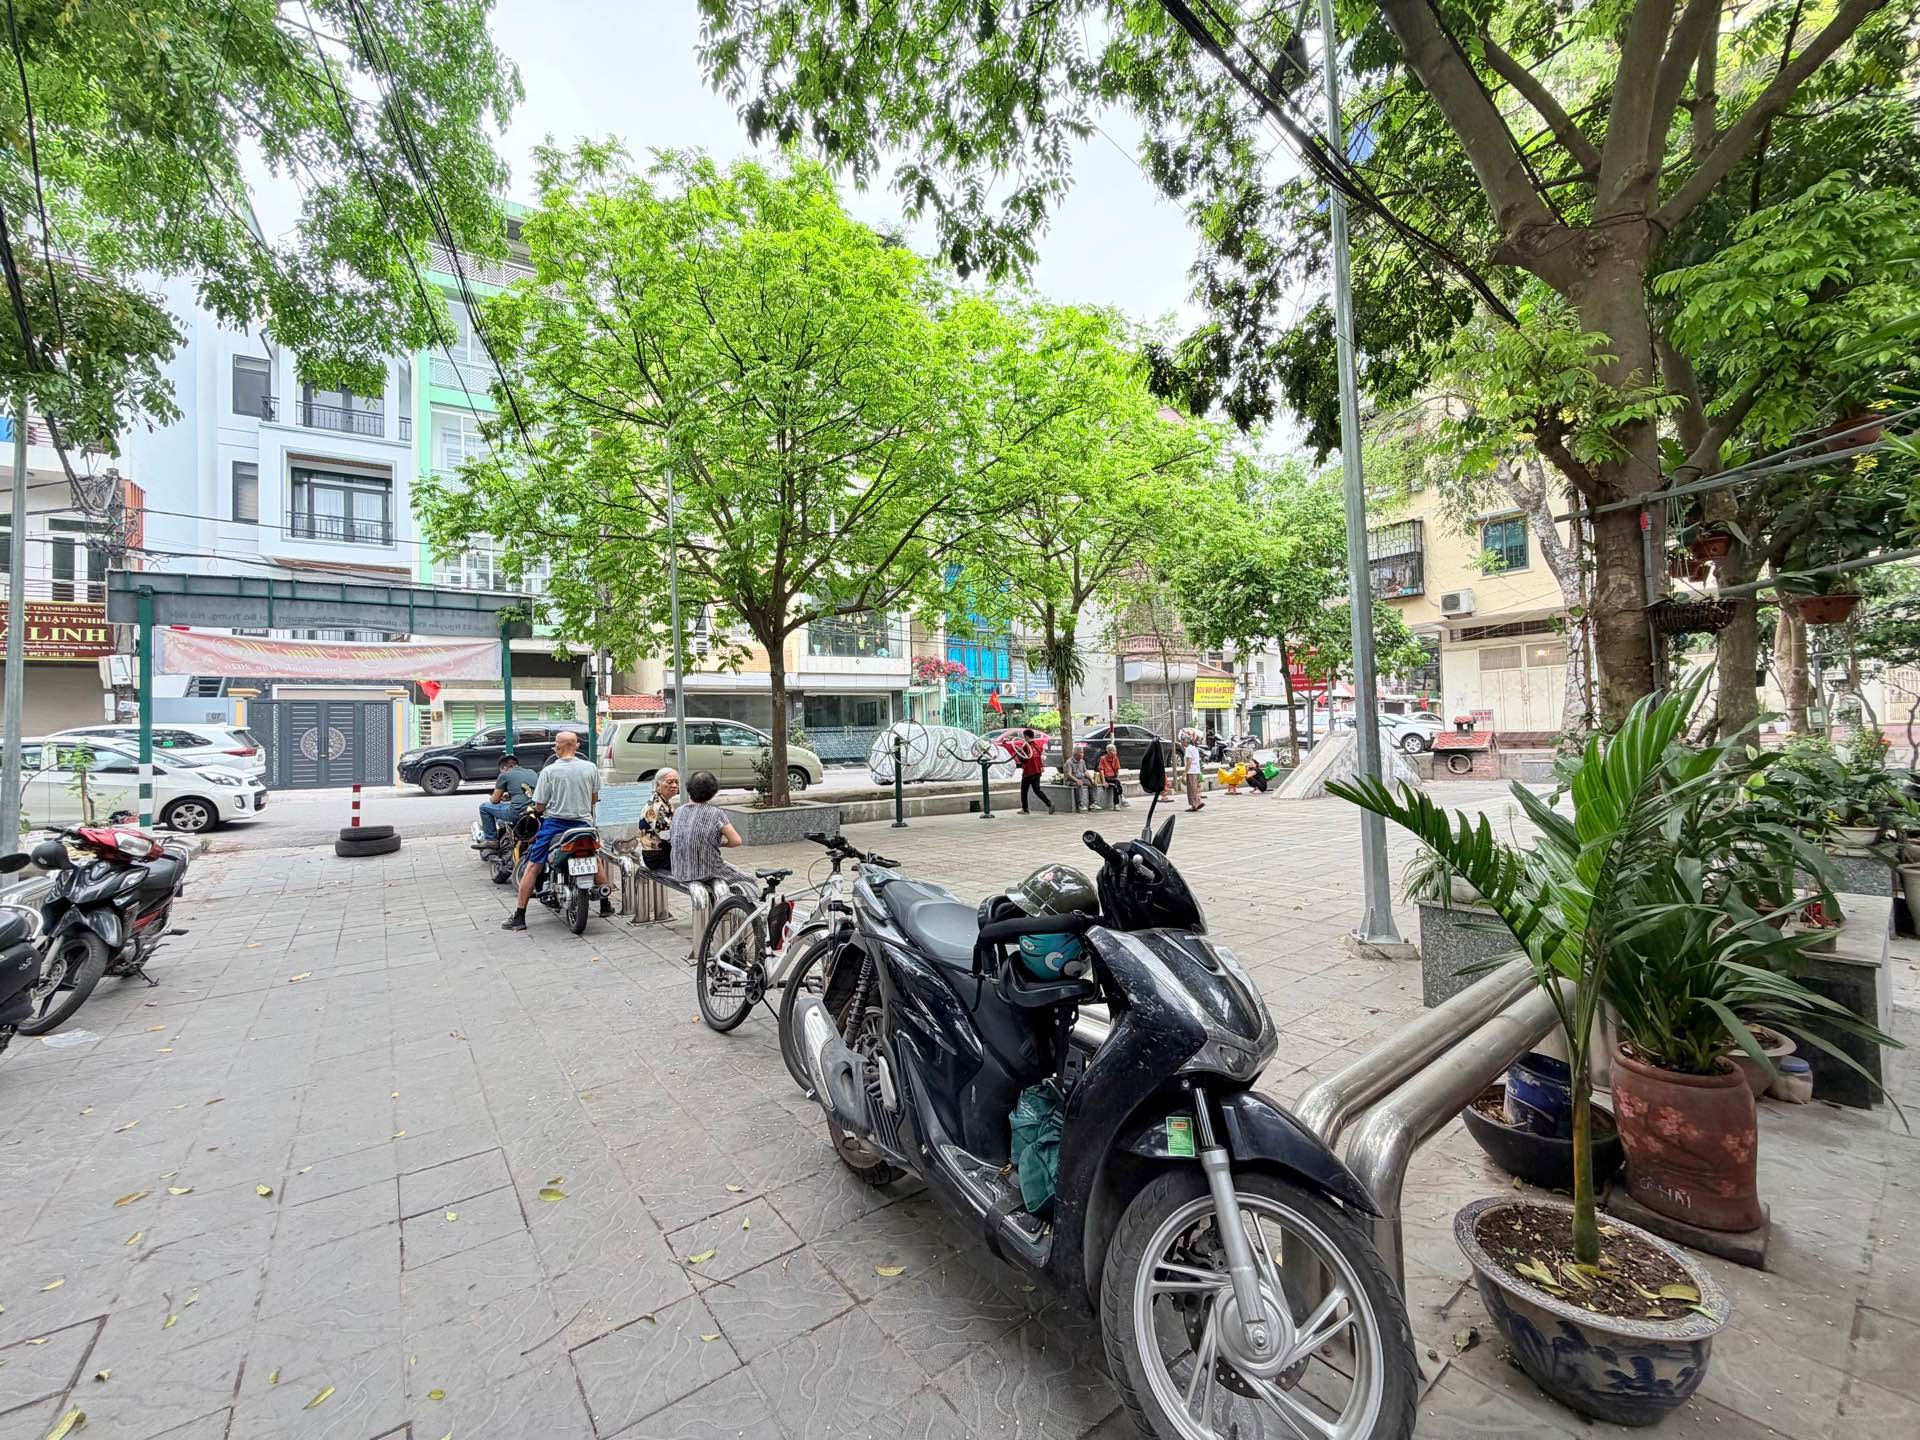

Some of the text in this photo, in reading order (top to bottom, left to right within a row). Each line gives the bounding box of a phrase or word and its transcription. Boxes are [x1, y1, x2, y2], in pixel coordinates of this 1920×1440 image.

[33, 604, 61, 612] THÀNH
[34, 616, 70, 624] LUẬT
[28, 627, 107, 642] LINH
